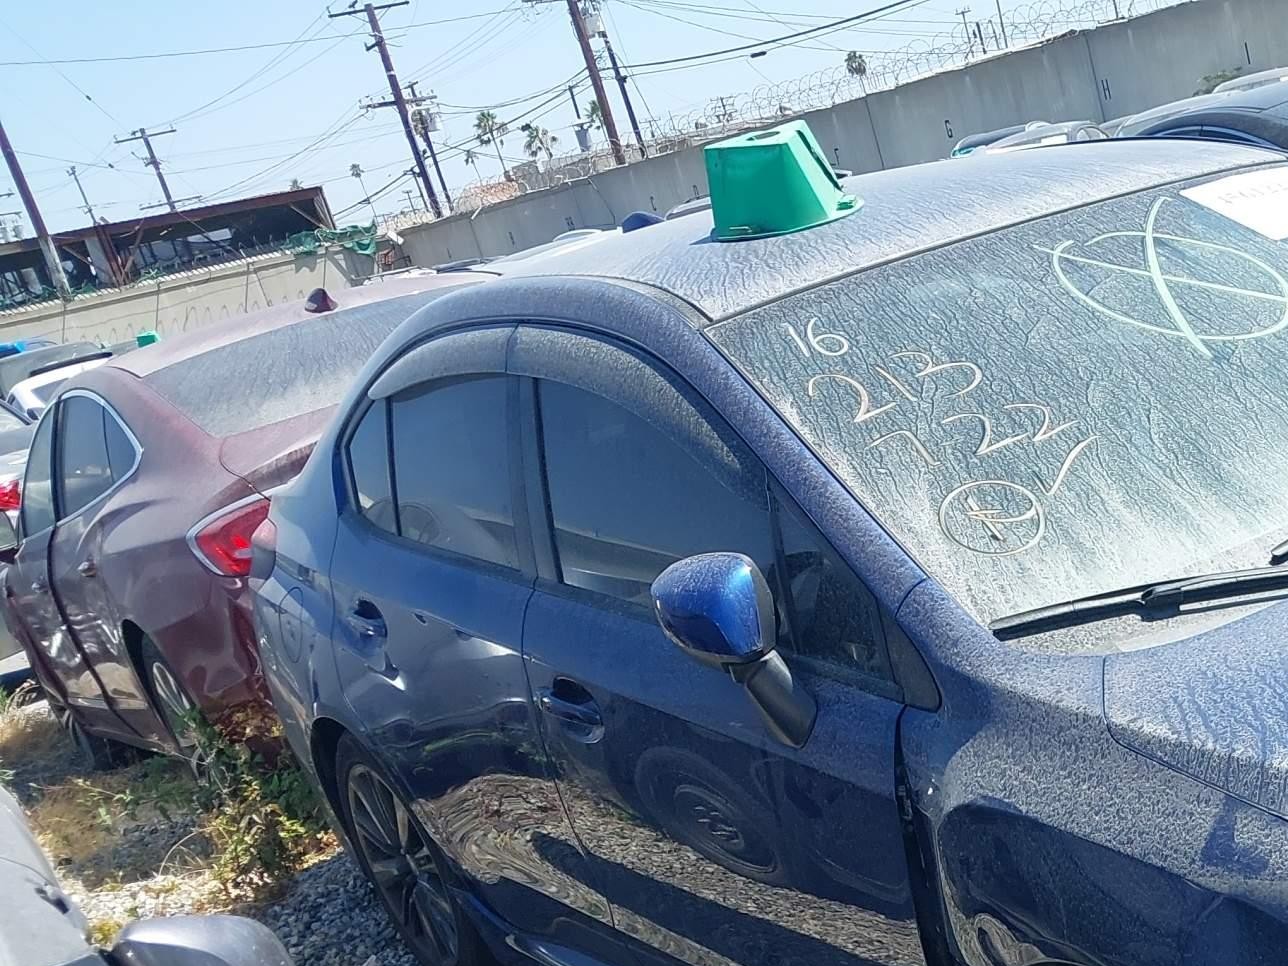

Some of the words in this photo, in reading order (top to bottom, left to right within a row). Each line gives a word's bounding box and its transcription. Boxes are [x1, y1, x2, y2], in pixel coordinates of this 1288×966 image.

[1101, 78, 1112, 101] H
[786, 316, 850, 357] 16
[807, 350, 983, 423] 213
